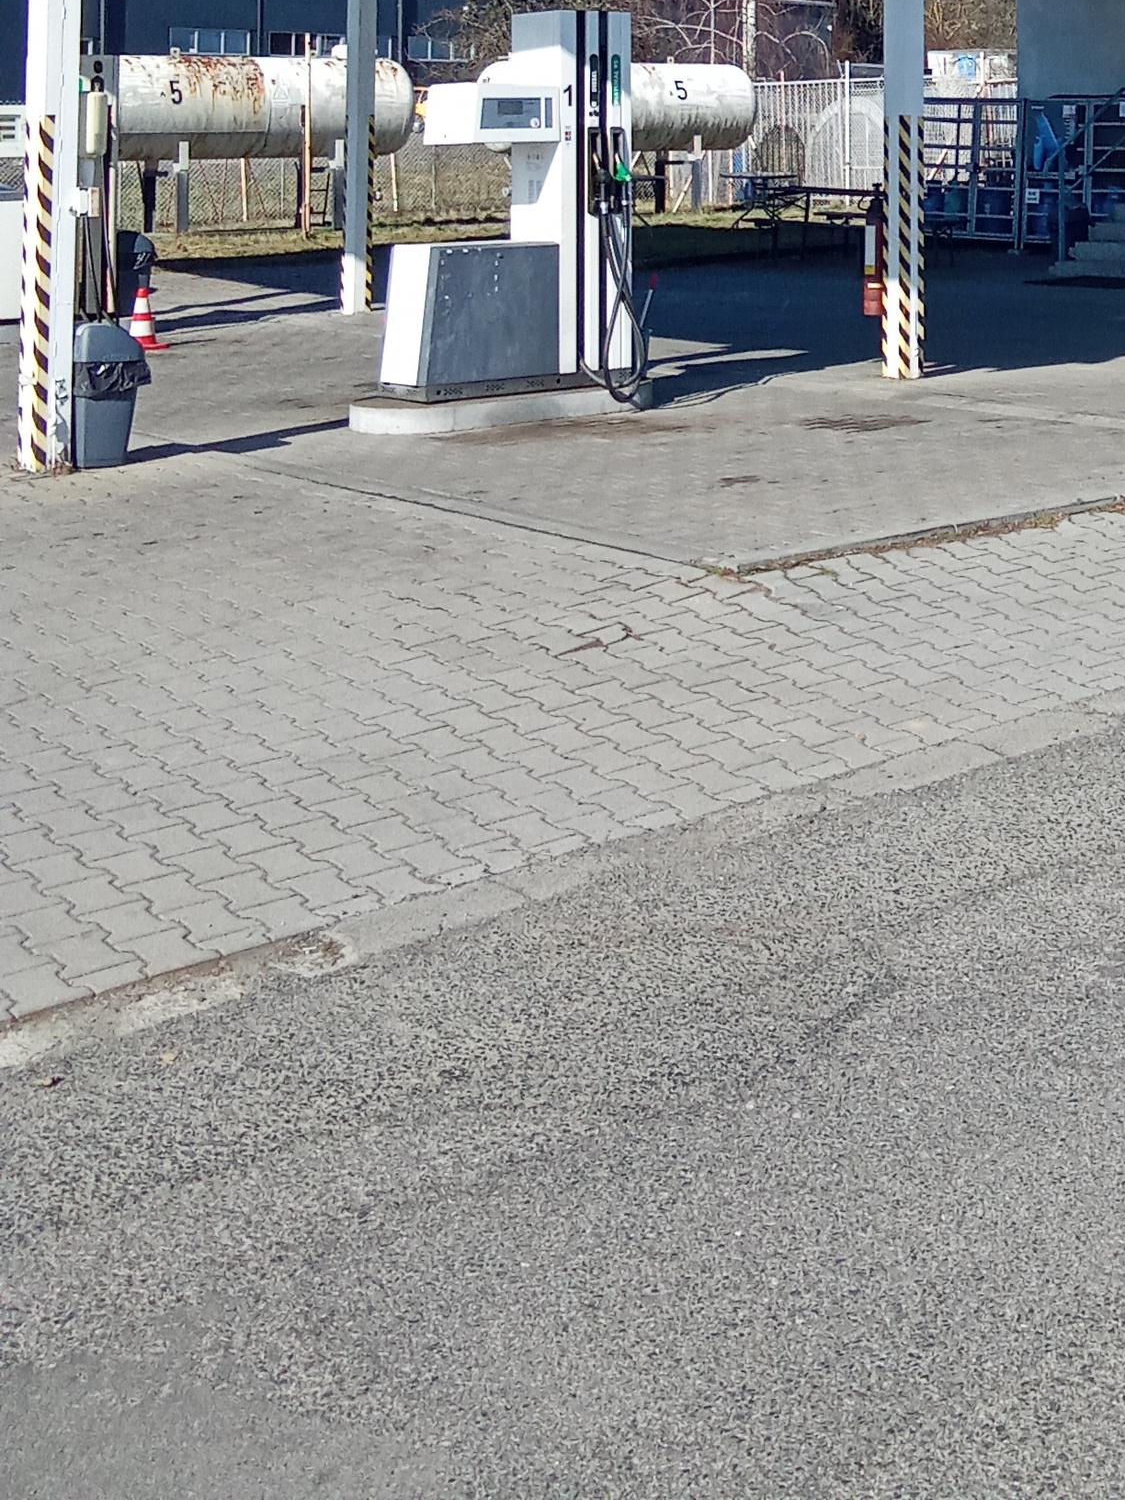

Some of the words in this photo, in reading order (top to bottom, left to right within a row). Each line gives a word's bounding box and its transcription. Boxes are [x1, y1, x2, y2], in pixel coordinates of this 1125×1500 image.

[169, 80, 183, 105] 5
[563, 84, 573, 107] 1
[674, 80, 688, 100] 5
